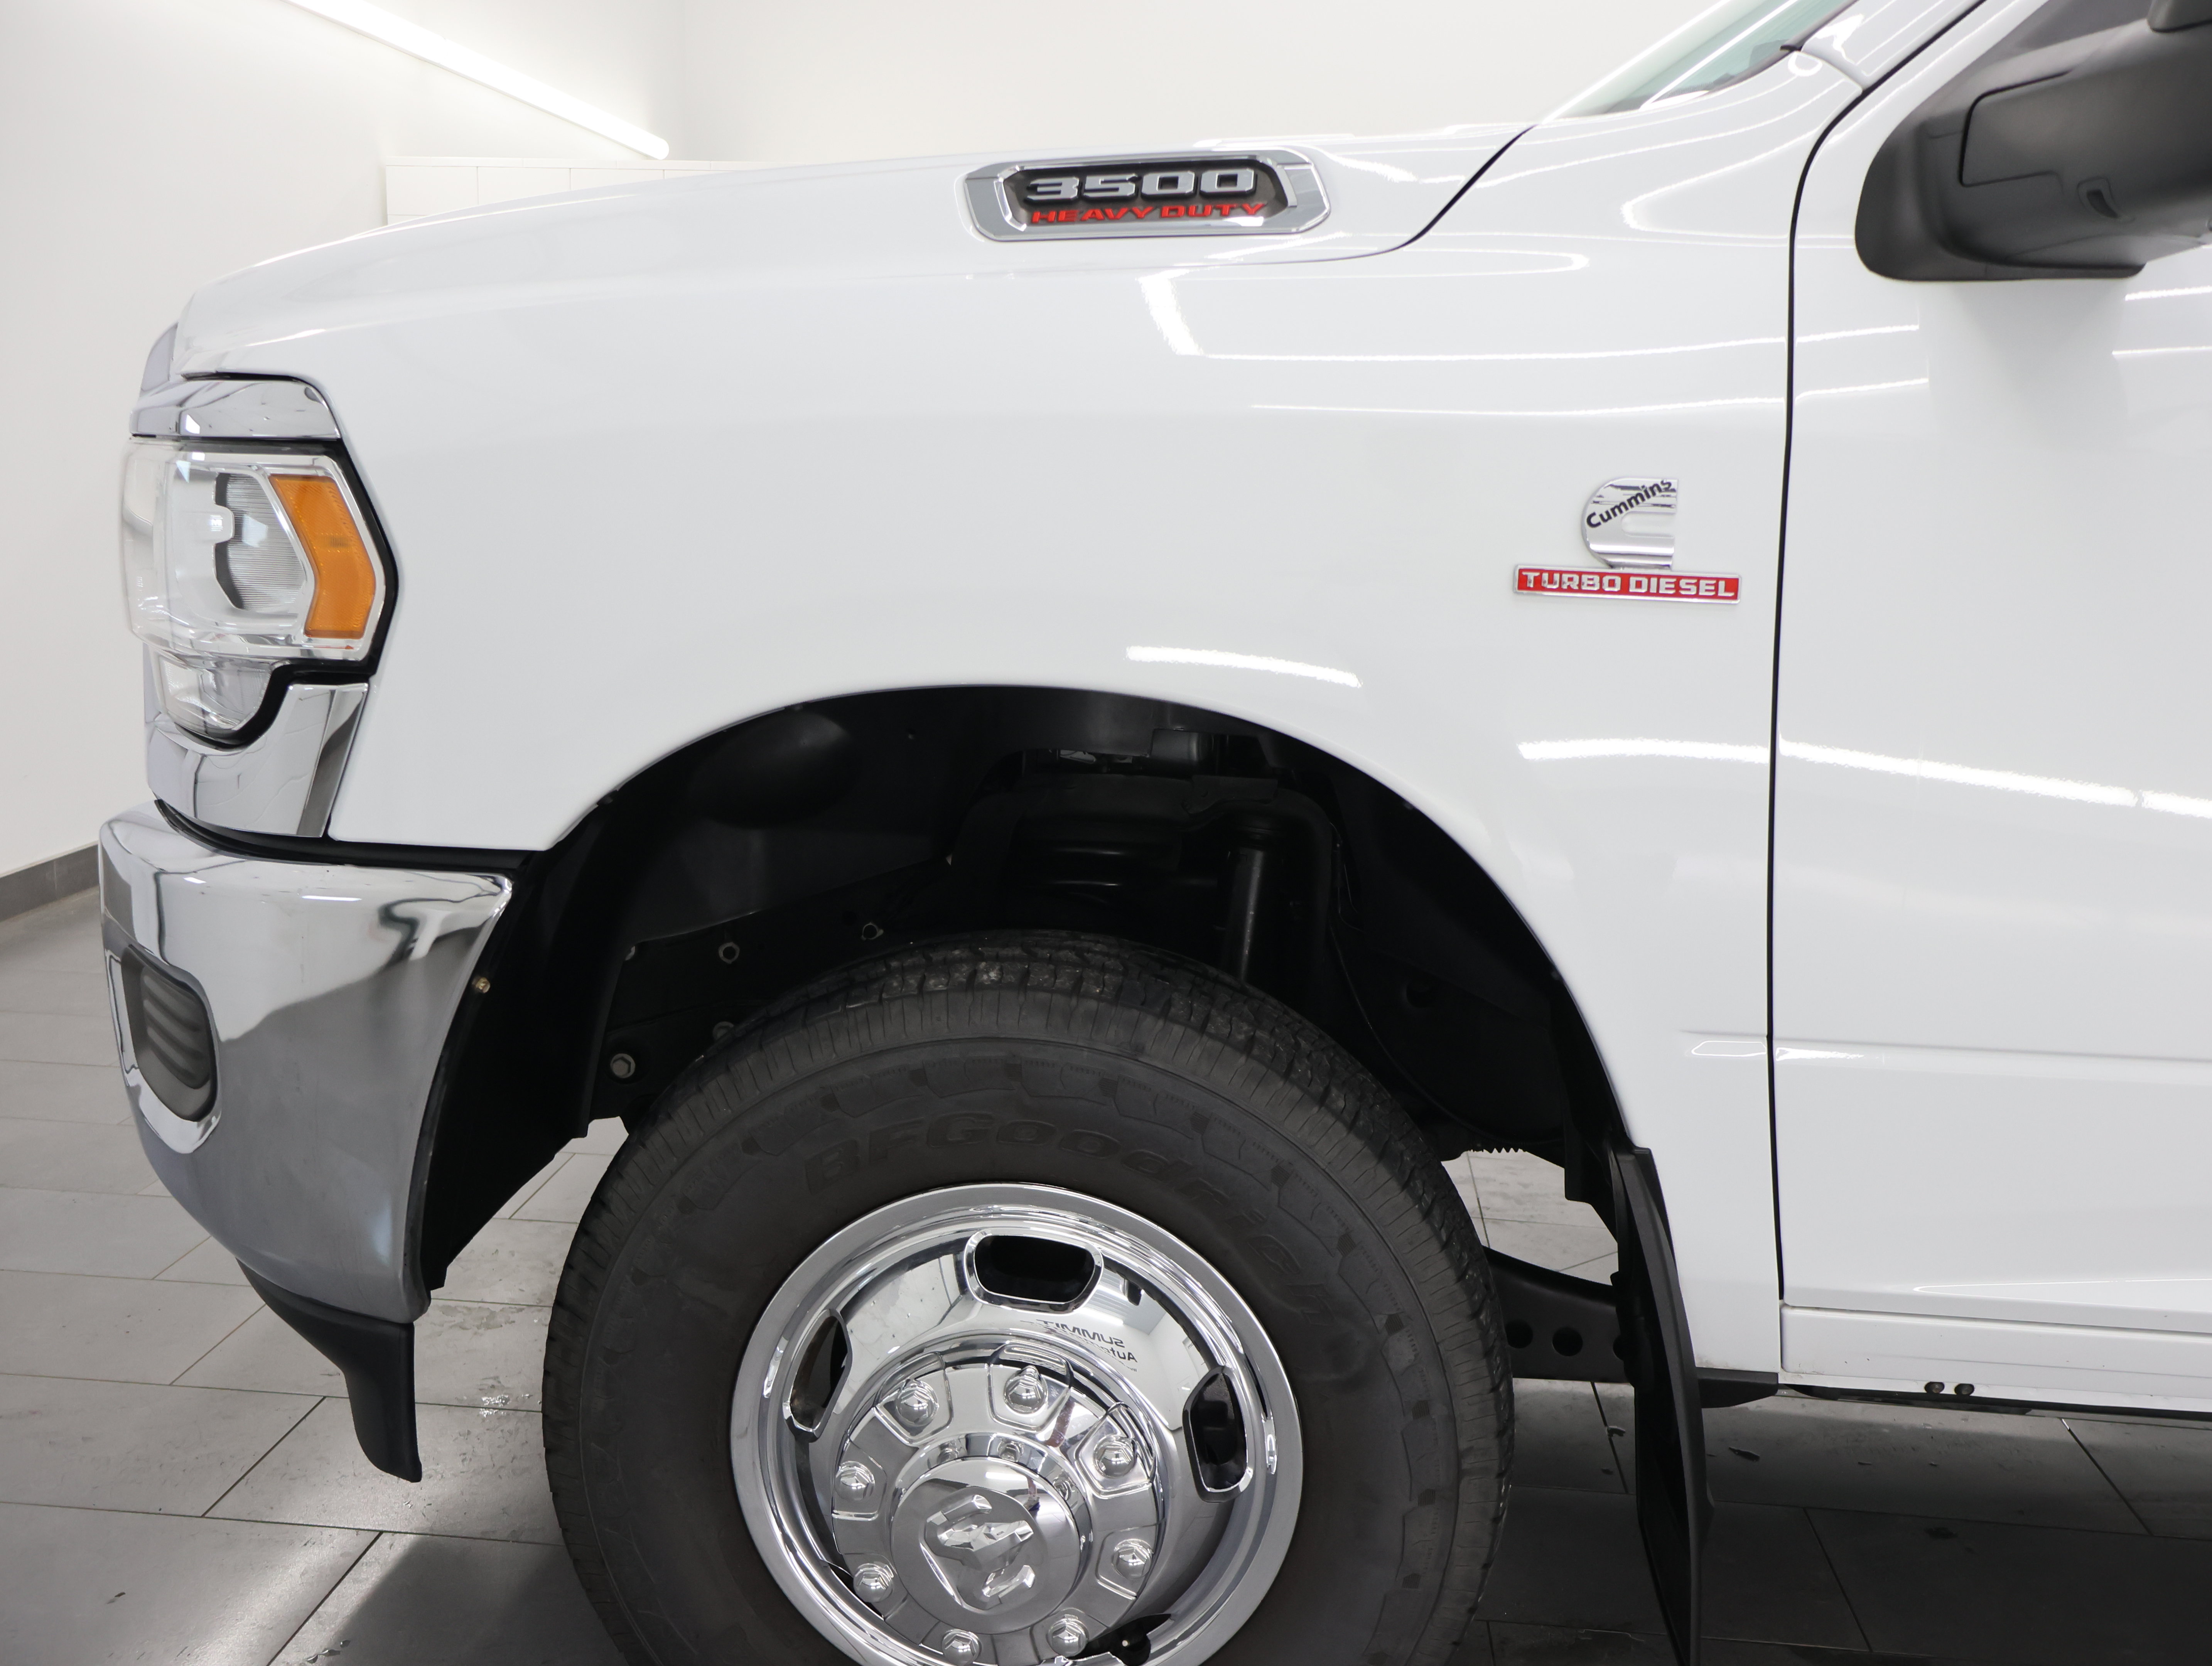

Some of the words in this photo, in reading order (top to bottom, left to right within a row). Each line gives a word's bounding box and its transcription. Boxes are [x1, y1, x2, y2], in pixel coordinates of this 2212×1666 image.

[1027, 168, 1255, 201] 3500
[1032, 207, 1154, 223] HEAVY
[1160, 203, 1266, 218] DUTY
[1586, 479, 1672, 529] Cummins
[1521, 571, 1622, 592] TURBO
[1628, 576, 1735, 597] DIESEL
